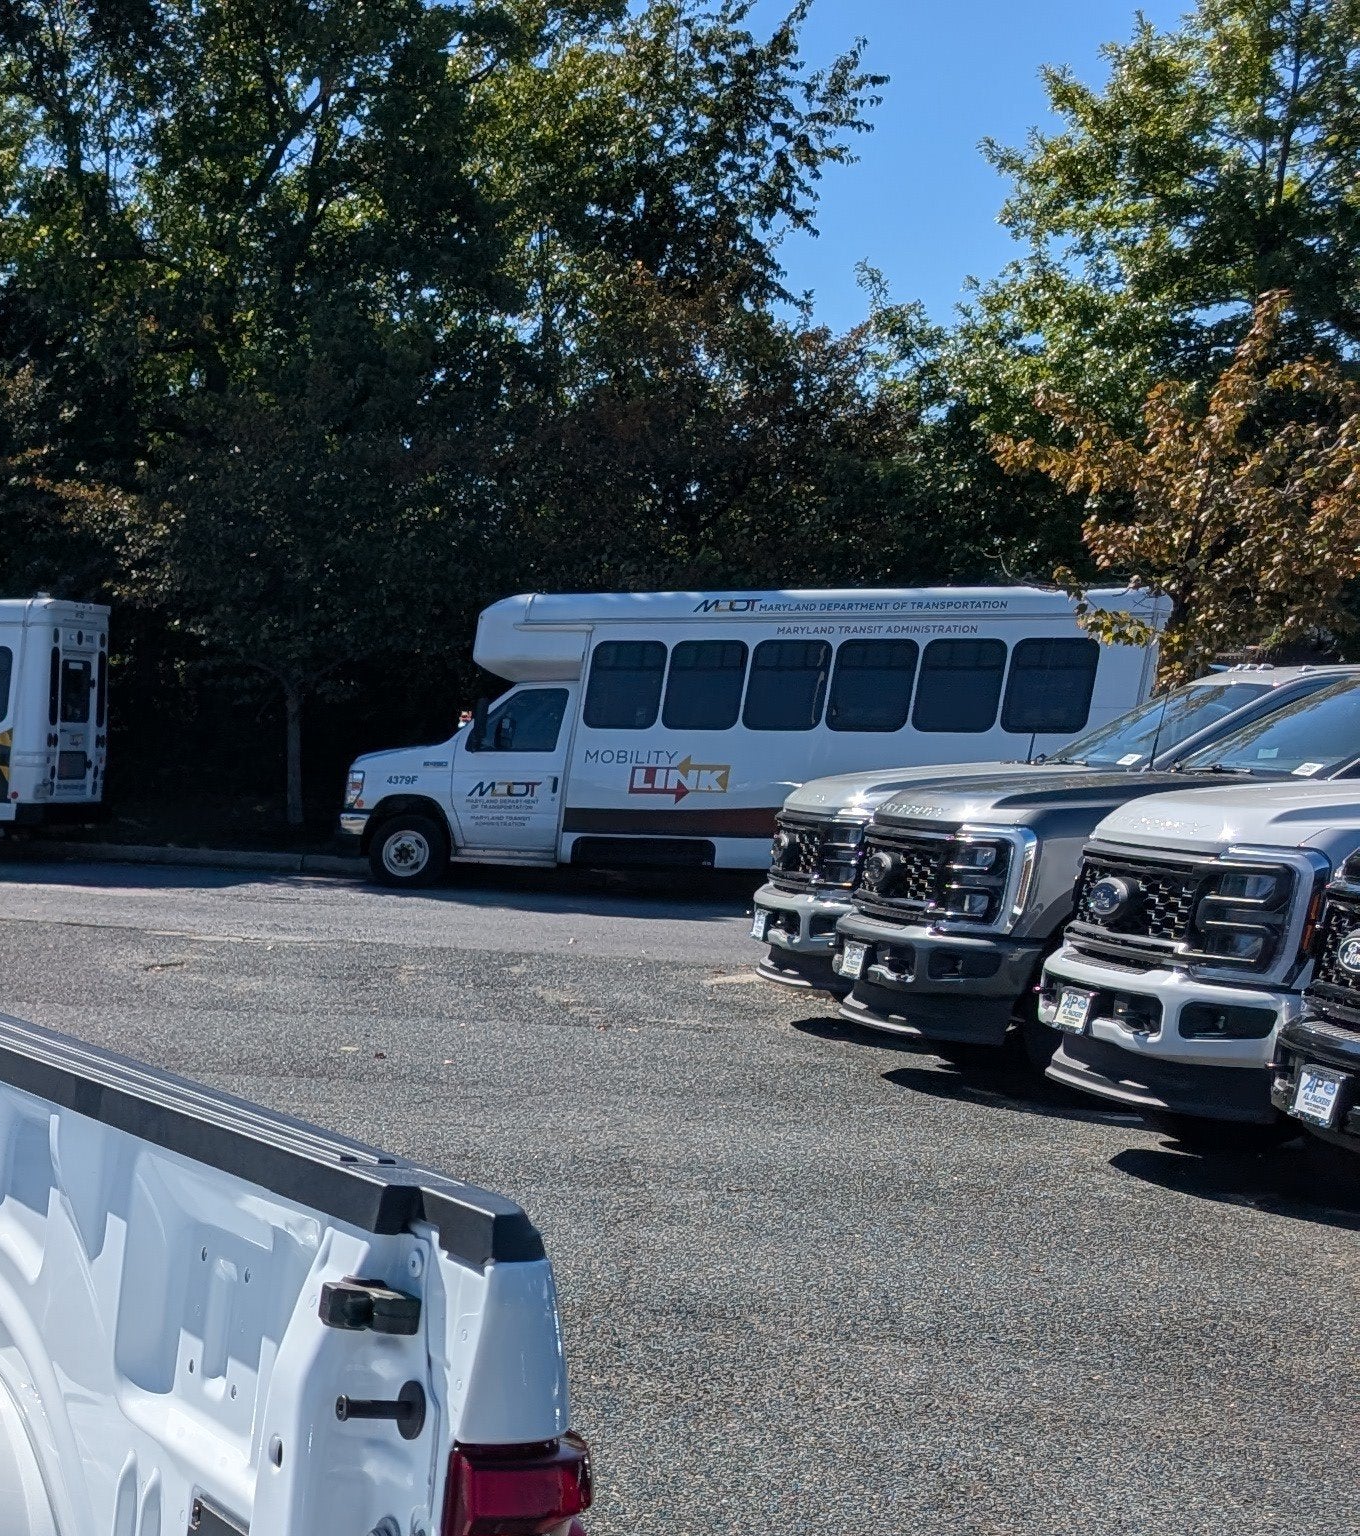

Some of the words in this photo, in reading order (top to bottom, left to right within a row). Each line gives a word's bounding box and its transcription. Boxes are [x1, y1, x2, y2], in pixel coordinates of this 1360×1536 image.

[759, 603, 816, 612] MARYLAND
[819, 602, 890, 612] DEPARTMENT
[892, 601, 907, 611] OF
[910, 600, 1008, 610] TRANSPORTATION
[777, 626, 835, 635] MARYLAND
[838, 625, 883, 635] TRANSIT
[885, 624, 978, 634] ADMINISTRATION
[584, 749, 679, 764] MOBILITY
[386, 775, 419, 785] 4379F
[632, 767, 728, 791] LINK
